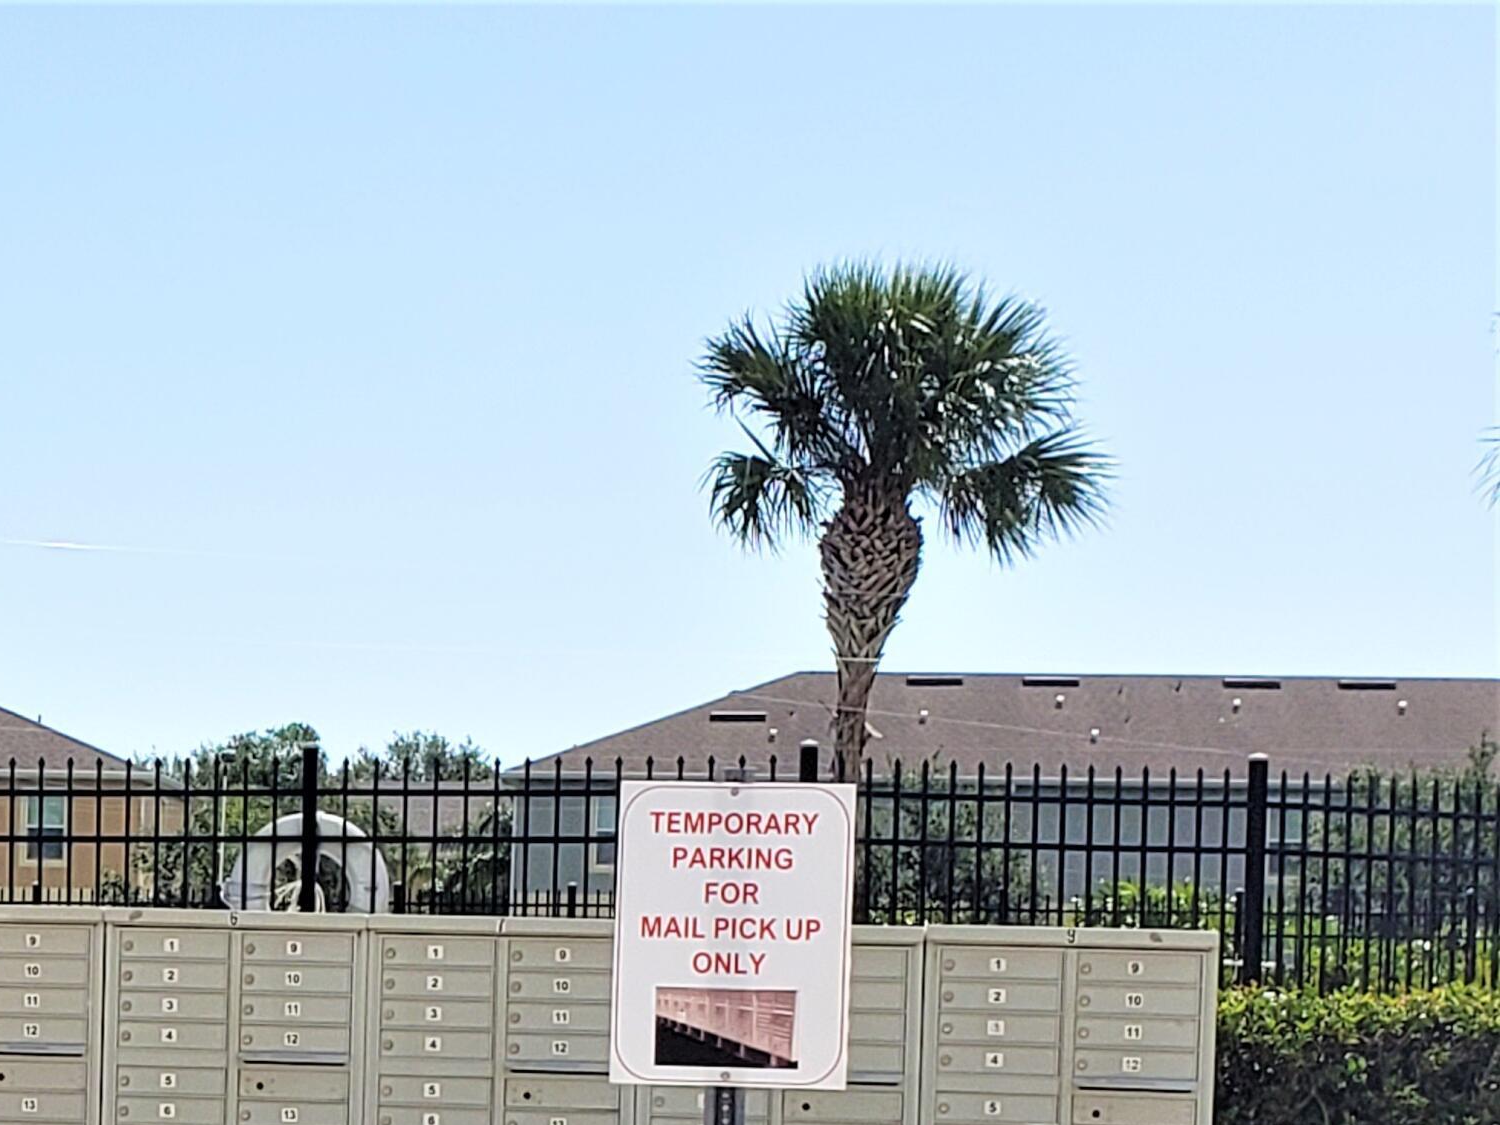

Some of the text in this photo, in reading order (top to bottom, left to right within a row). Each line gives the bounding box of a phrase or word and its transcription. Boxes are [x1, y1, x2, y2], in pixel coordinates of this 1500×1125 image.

[649, 811, 820, 836] TEMPORARY
[671, 847, 794, 870] PARKING
[703, 882, 759, 905] FOR
[640, 916, 821, 941] MAIL PICK UP
[692, 952, 766, 976] ONLY
[27, 966, 39, 976] 10
[287, 974, 300, 984] 10
[555, 980, 569, 991] 10
[27, 995, 38, 1005] 11
[1128, 995, 1142, 1006] 10
[287, 1004, 298, 1014] 11
[555, 1012, 567, 1022] 11
[26, 1025, 38, 1036] 12
[1127, 1027, 1140, 1037] 11
[286, 1034, 298, 1045] 12
[554, 1042, 567, 1053] 12
[24, 1100, 36, 1110] 13
[284, 1110, 296, 1120] 13
